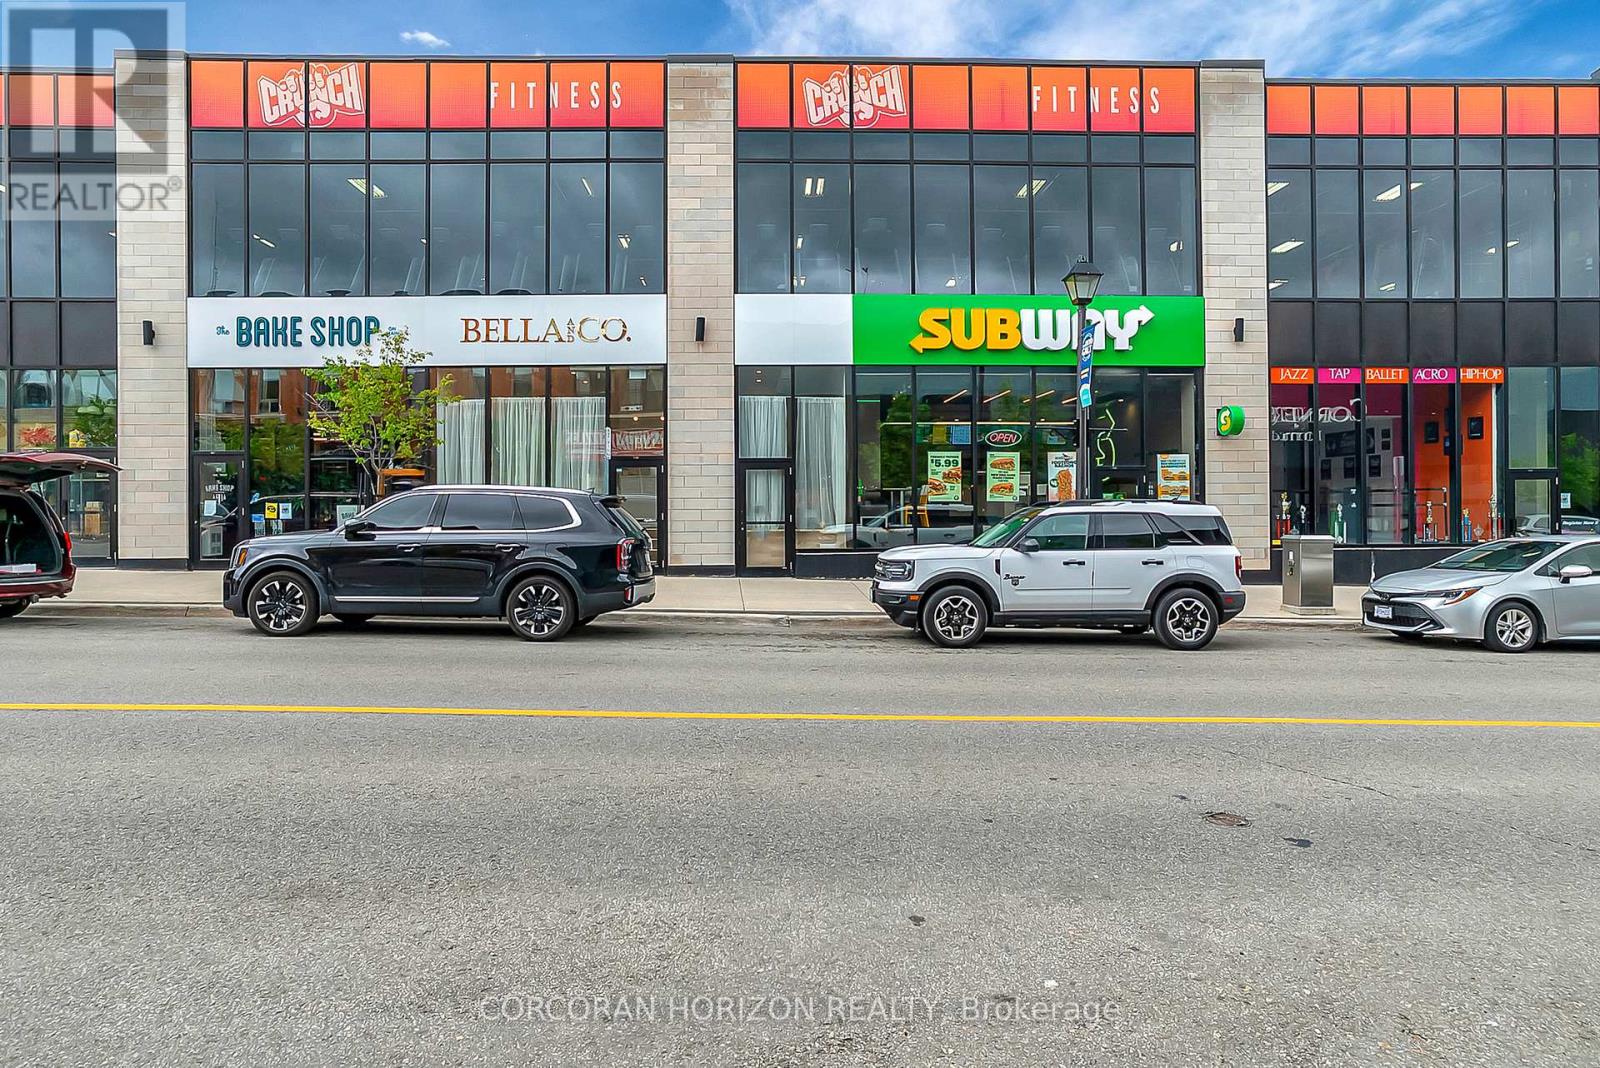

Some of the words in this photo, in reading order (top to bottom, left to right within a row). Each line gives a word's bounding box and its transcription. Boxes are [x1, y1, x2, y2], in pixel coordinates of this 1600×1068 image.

[490, 81, 622, 109] FITNESS
[1033, 85, 1160, 113] FITNESS
[236, 316, 302, 347] BAKE
[310, 316, 380, 347] SHOP
[460, 318, 566, 343] BELLA
[577, 317, 631, 343] CO.
[909, 304, 1155, 353] SUBWAY
[1280, 368, 1308, 380] JAZZ
[1328, 368, 1350, 379] TAP
[1366, 368, 1405, 380] BALLET
[1415, 368, 1448, 381] ACRO
[990, 433, 1017, 443] OPEN
